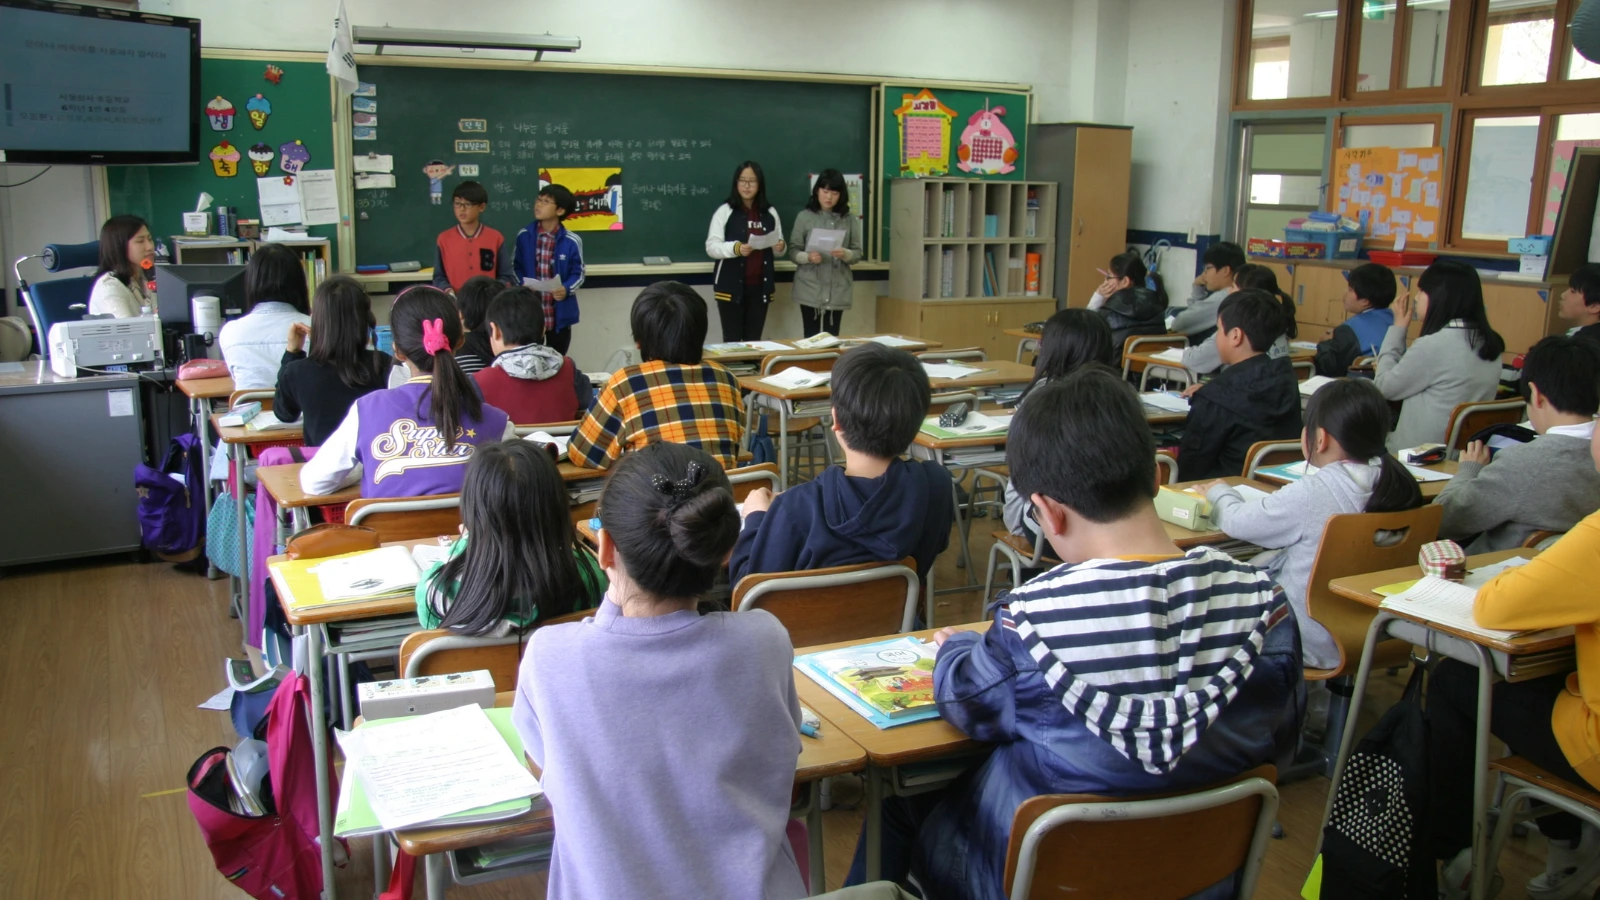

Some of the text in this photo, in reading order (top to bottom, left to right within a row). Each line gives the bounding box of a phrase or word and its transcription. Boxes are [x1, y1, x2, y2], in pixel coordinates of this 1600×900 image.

[251, 110, 266, 127] 일
[218, 157, 298, 175] 축 하 해
[480, 248, 494, 271] B
